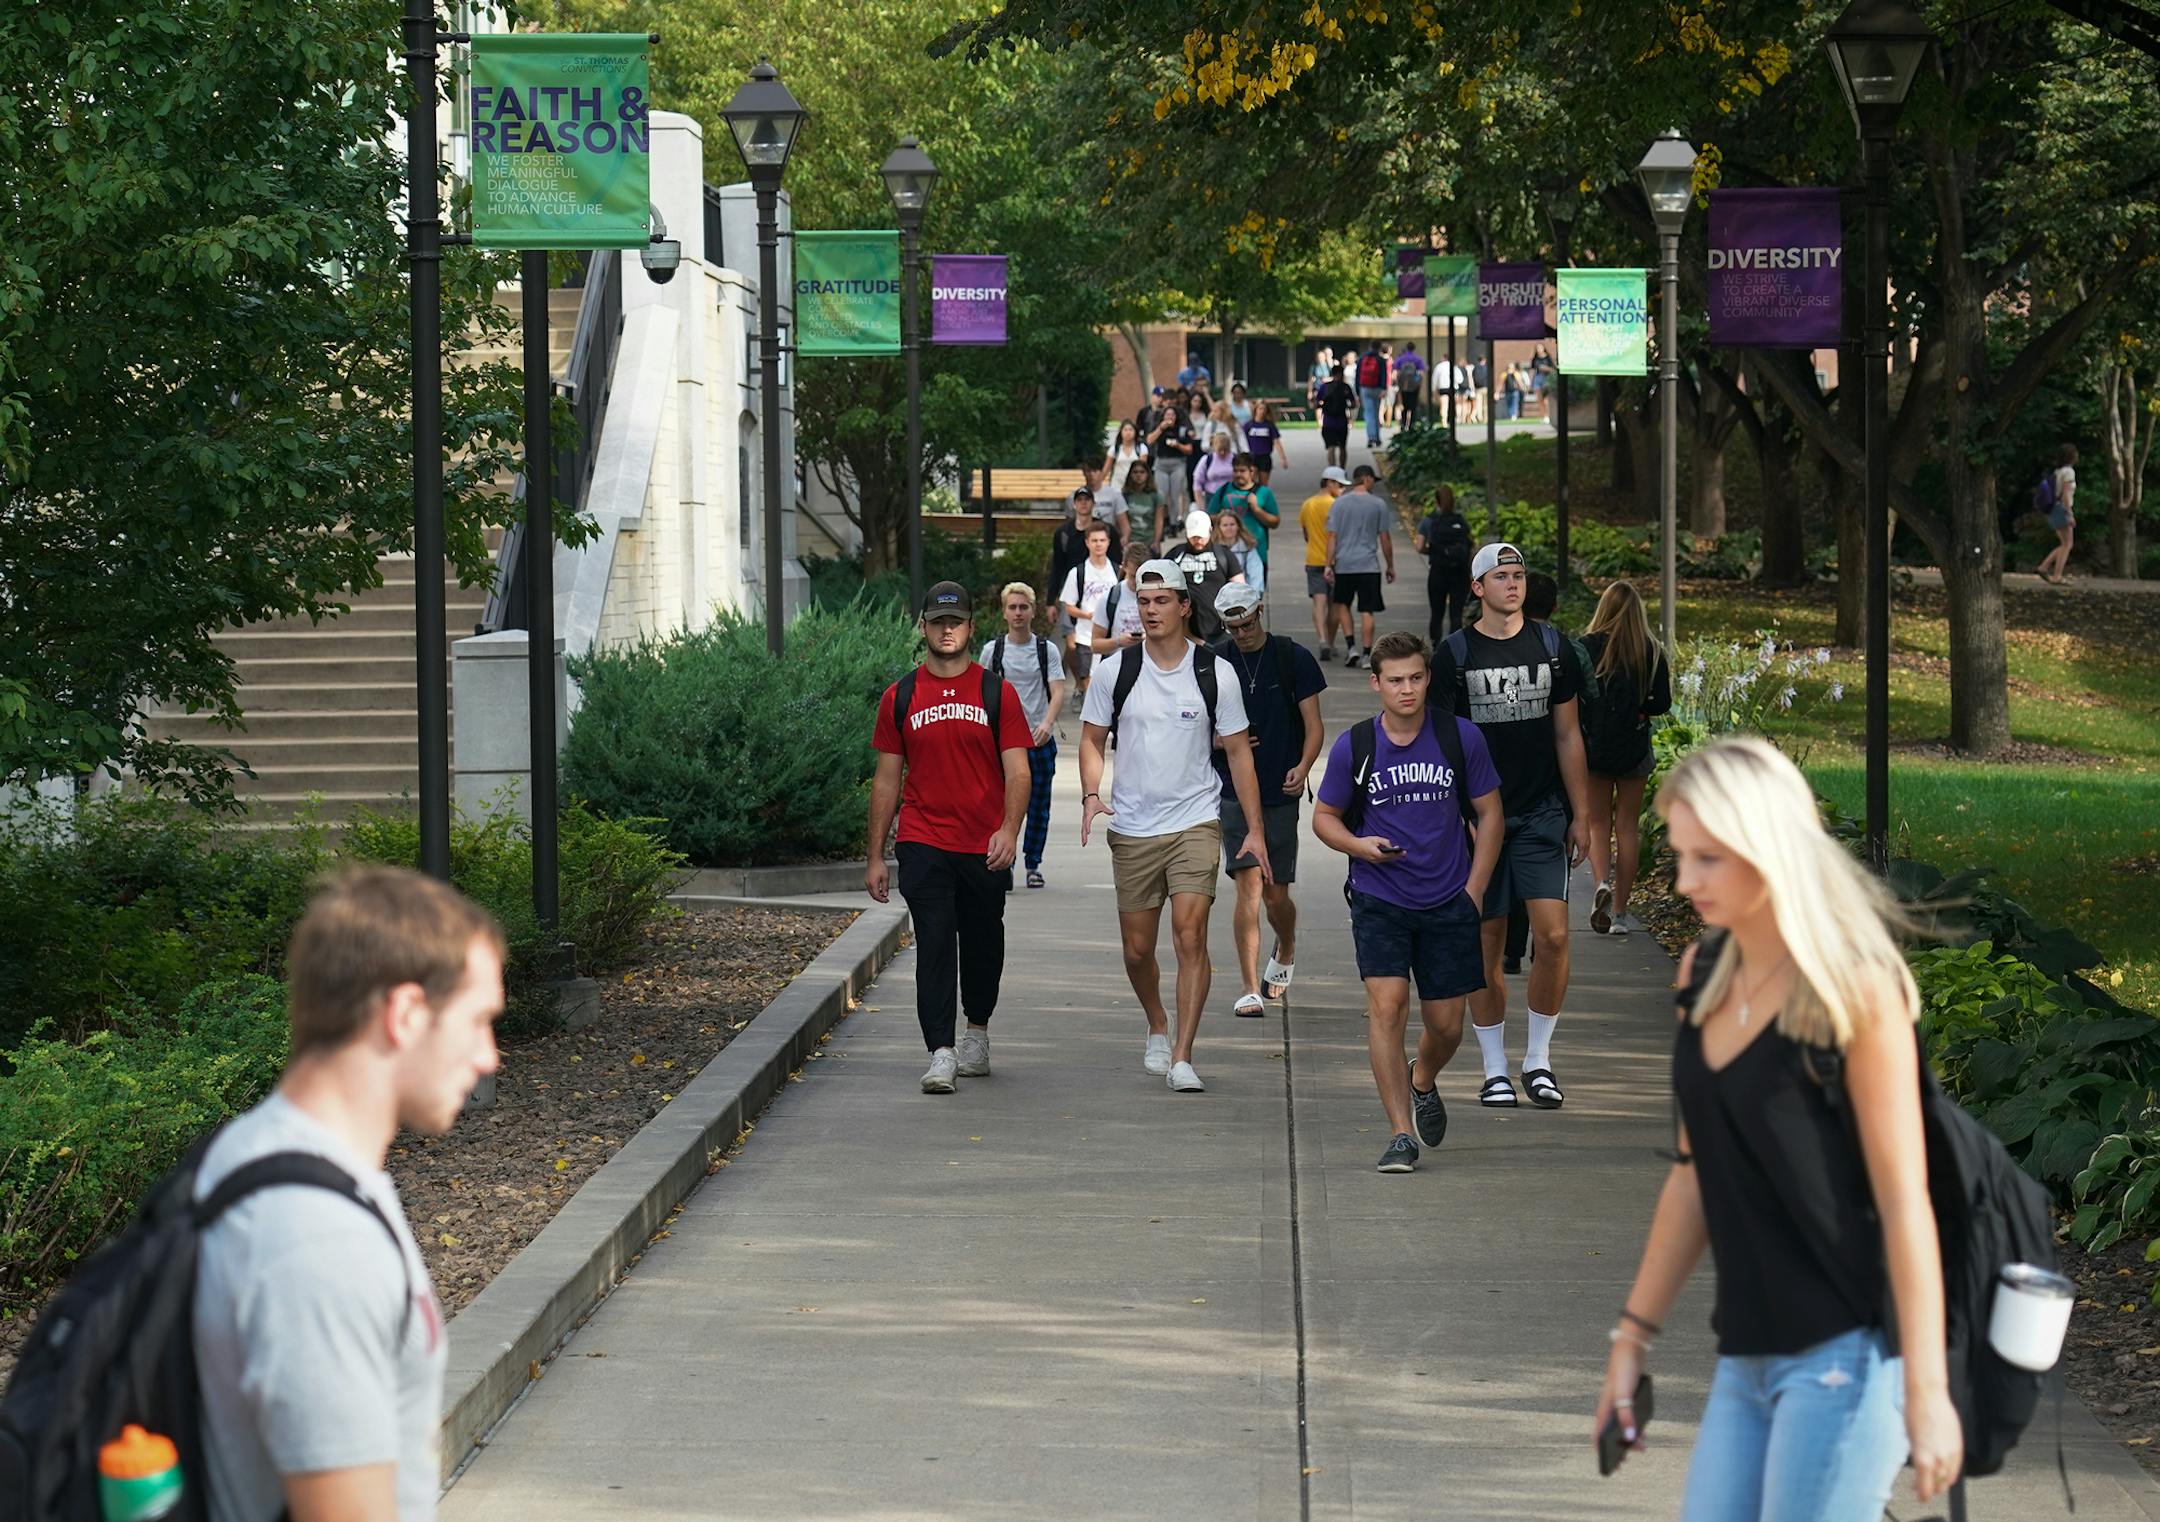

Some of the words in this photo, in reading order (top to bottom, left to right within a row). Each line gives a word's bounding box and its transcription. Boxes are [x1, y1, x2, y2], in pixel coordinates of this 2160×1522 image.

[574, 57, 588, 65] ST.
[590, 57, 629, 65] THOMAS
[560, 65, 627, 73] CONVICTIONS
[472, 87, 602, 121] FAITH
[618, 86, 649, 122] &
[472, 121, 649, 154] REASON
[487, 155, 509, 166] WE
[512, 155, 564, 166] FOSTER
[487, 167, 578, 179] MEANINGFUL
[487, 179, 559, 191] DIALOGUE
[487, 191, 507, 202] TO
[510, 191, 576, 203] ADVANCE
[487, 203, 541, 215] HUMAN
[543, 203, 603, 215] CULTURE
[1708, 247, 1842, 269] DIVERSITY
[1722, 273, 1742, 284] WE
[1745, 273, 1787, 284] STRIVE
[797, 280, 900, 294] GRATITUDE
[1480, 282, 1544, 296] PURSUIT
[1722, 285, 1740, 296] TO
[1743, 284, 1790, 296] CREATE
[1793, 284, 1803, 295] A
[932, 287, 1008, 301] DIVERSITY
[823, 296, 874, 305] CELEBRATE
[1480, 296, 1499, 307] OF
[1502, 295, 1545, 307] TRUTH
[1559, 298, 1646, 311] PERSONAL
[1722, 295, 1776, 307] VIBRANT
[1778, 295, 1831, 306] DIVERSE
[1559, 311, 1647, 324] ATTENTION
[1722, 307, 1802, 318] COMMUNITY
[911, 703, 989, 730] WISCONSIN
[1368, 772, 1389, 794] ST.
[1387, 762, 1455, 787] THOMAS
[1397, 791, 1450, 803] TOMMIES
